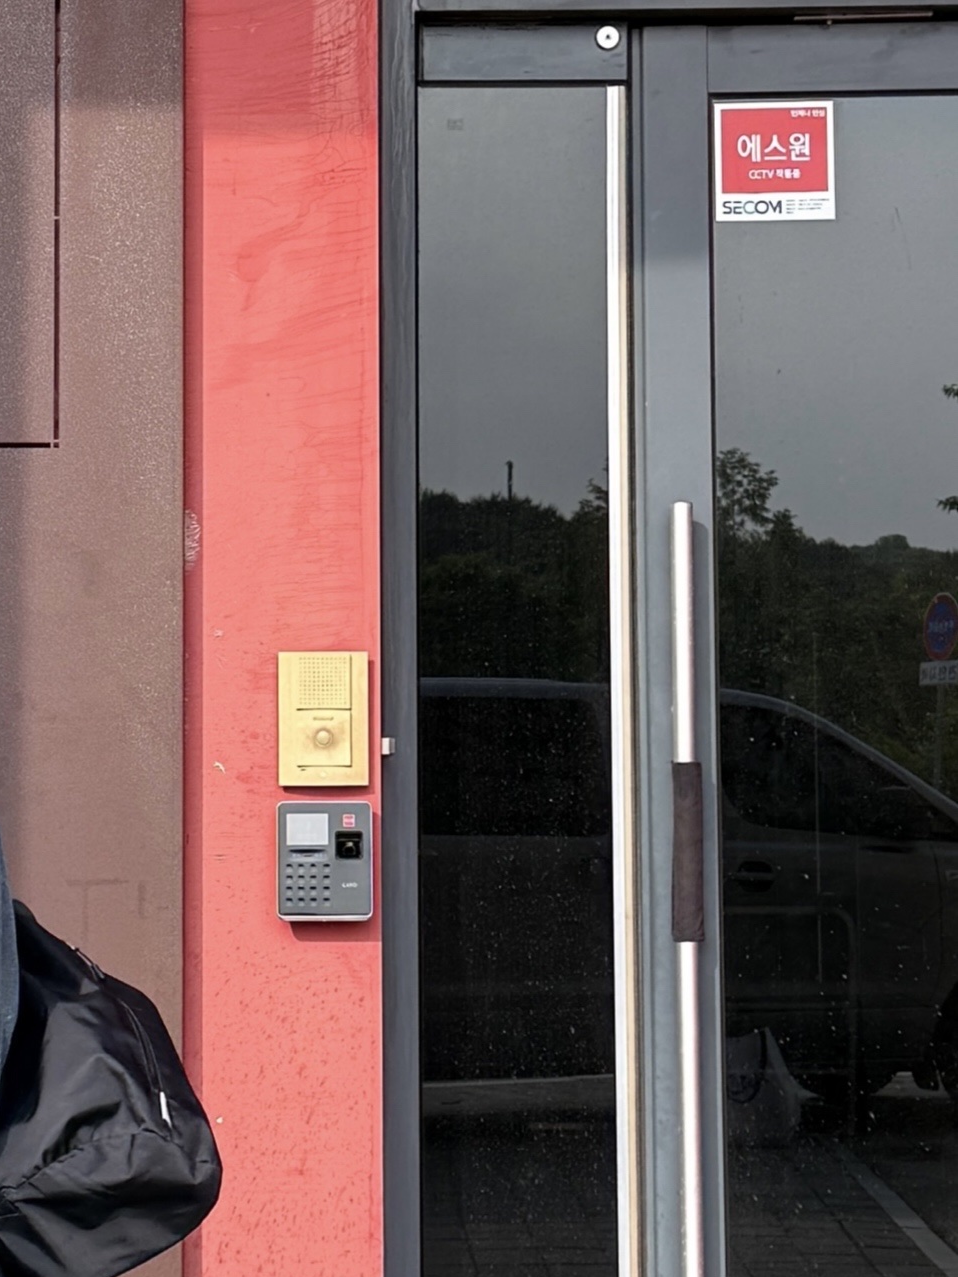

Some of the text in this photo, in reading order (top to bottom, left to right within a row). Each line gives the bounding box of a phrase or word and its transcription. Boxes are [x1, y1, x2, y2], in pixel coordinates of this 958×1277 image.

[737, 133, 811, 162] 에스원
[748, 169, 774, 180] CCTV
[722, 200, 783, 215] SECOM
